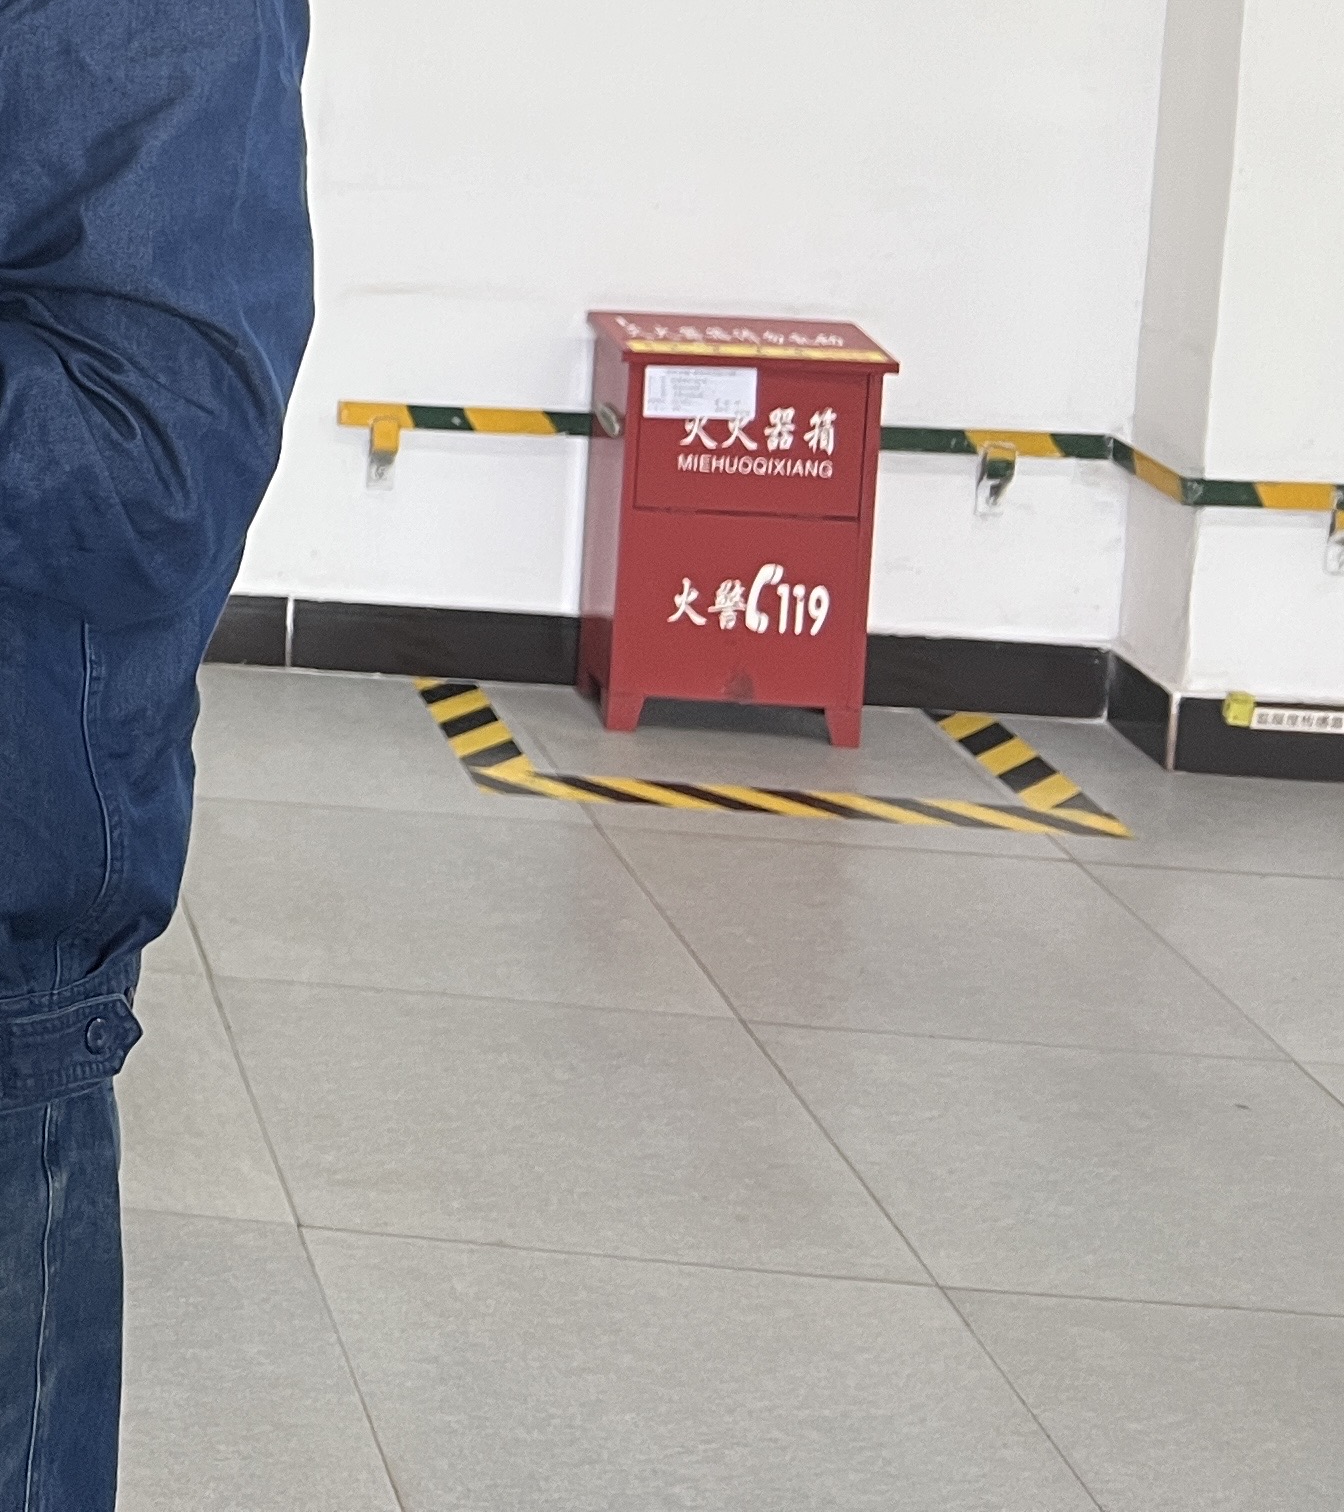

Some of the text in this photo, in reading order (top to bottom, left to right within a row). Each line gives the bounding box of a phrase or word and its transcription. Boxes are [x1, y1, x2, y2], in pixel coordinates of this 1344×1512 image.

[677, 454, 833, 479] MIEHUOQIXIANG
[667, 577, 830, 636] 火警 119
